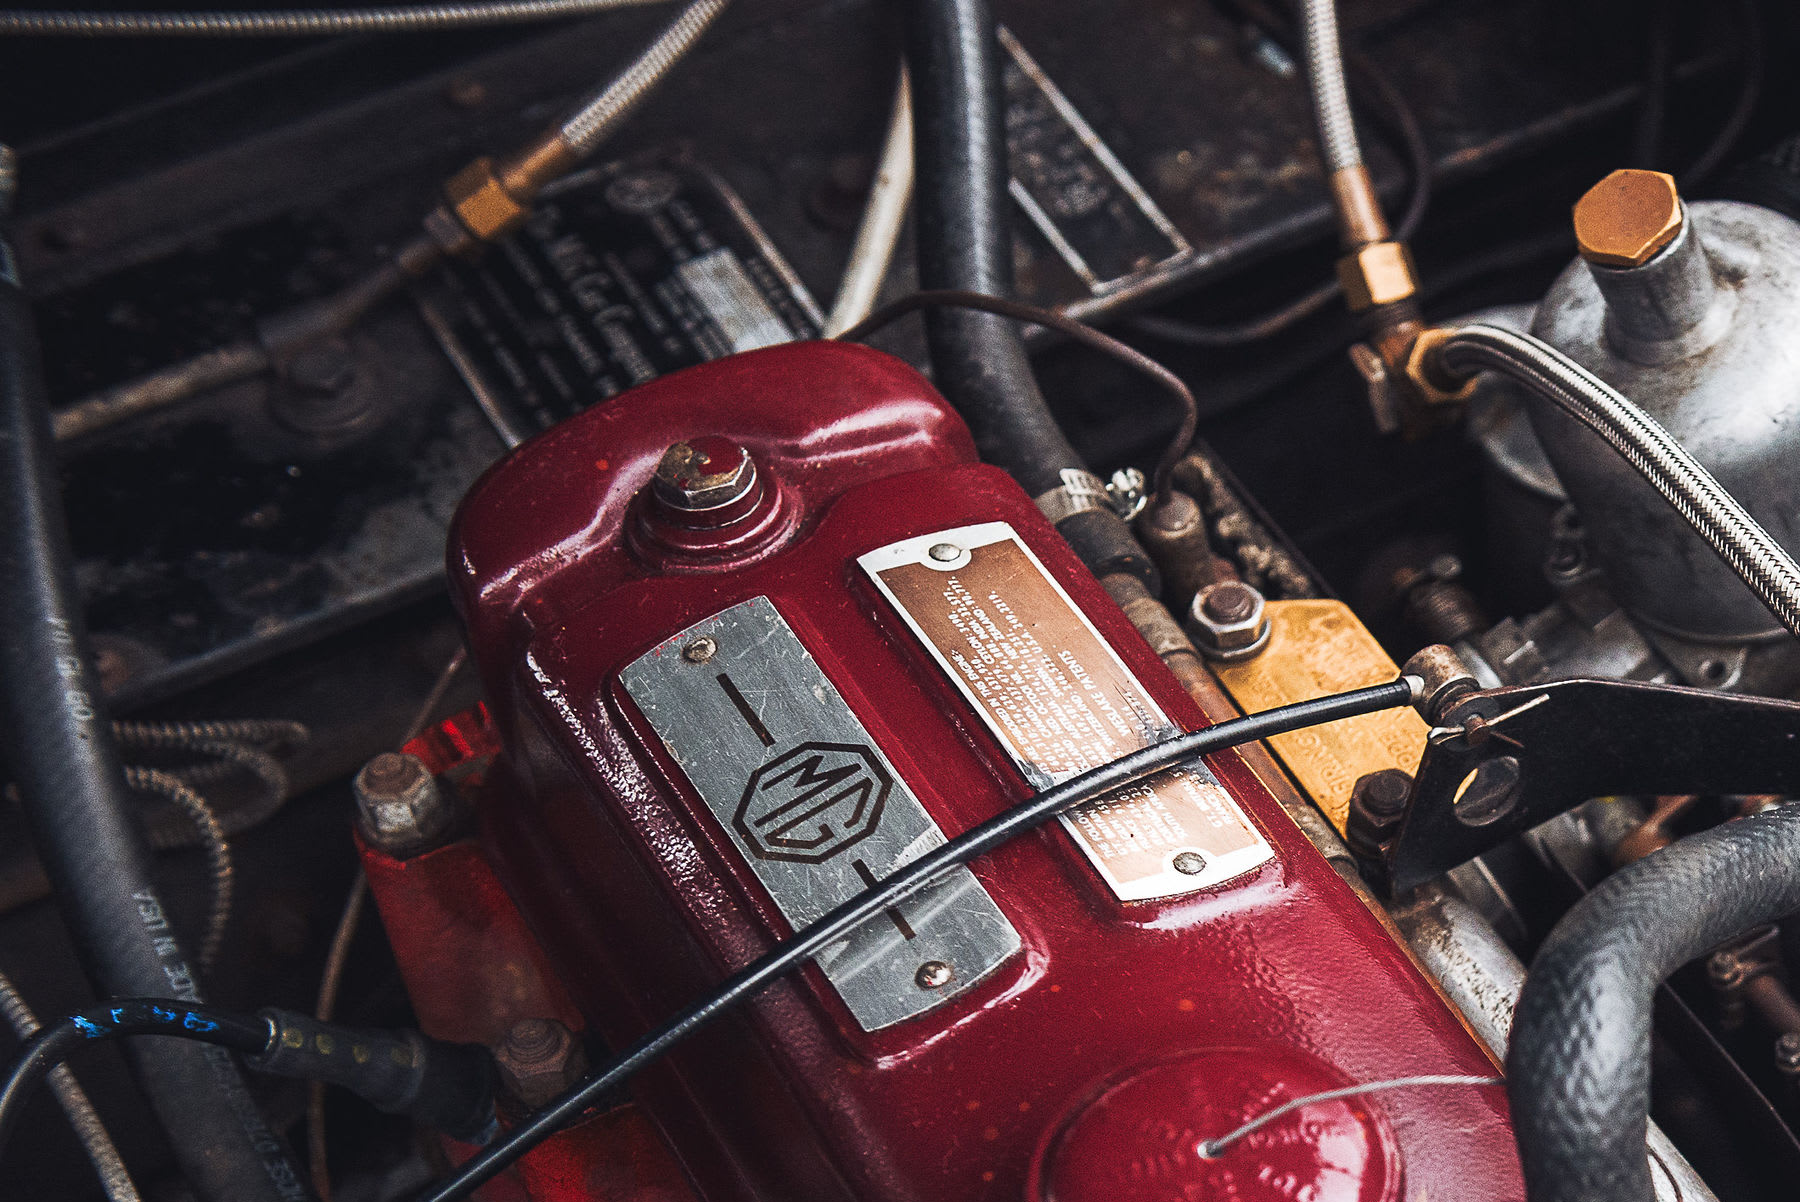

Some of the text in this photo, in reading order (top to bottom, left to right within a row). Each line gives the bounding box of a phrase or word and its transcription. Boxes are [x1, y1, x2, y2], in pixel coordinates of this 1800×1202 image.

[971, 606, 1004, 640] ZEALAND:
[966, 633, 995, 664] CEYLON:
[1001, 641, 1019, 658] NEW
[976, 681, 992, 696] THIS
[1059, 650, 1132, 735] WESLAKE PATENTS
[996, 708, 1029, 744] EMBODIED
[1026, 746, 1041, 760] ARE
[748, 749, 879, 854] MG
[1074, 810, 1115, 857] THE FOLLOW
